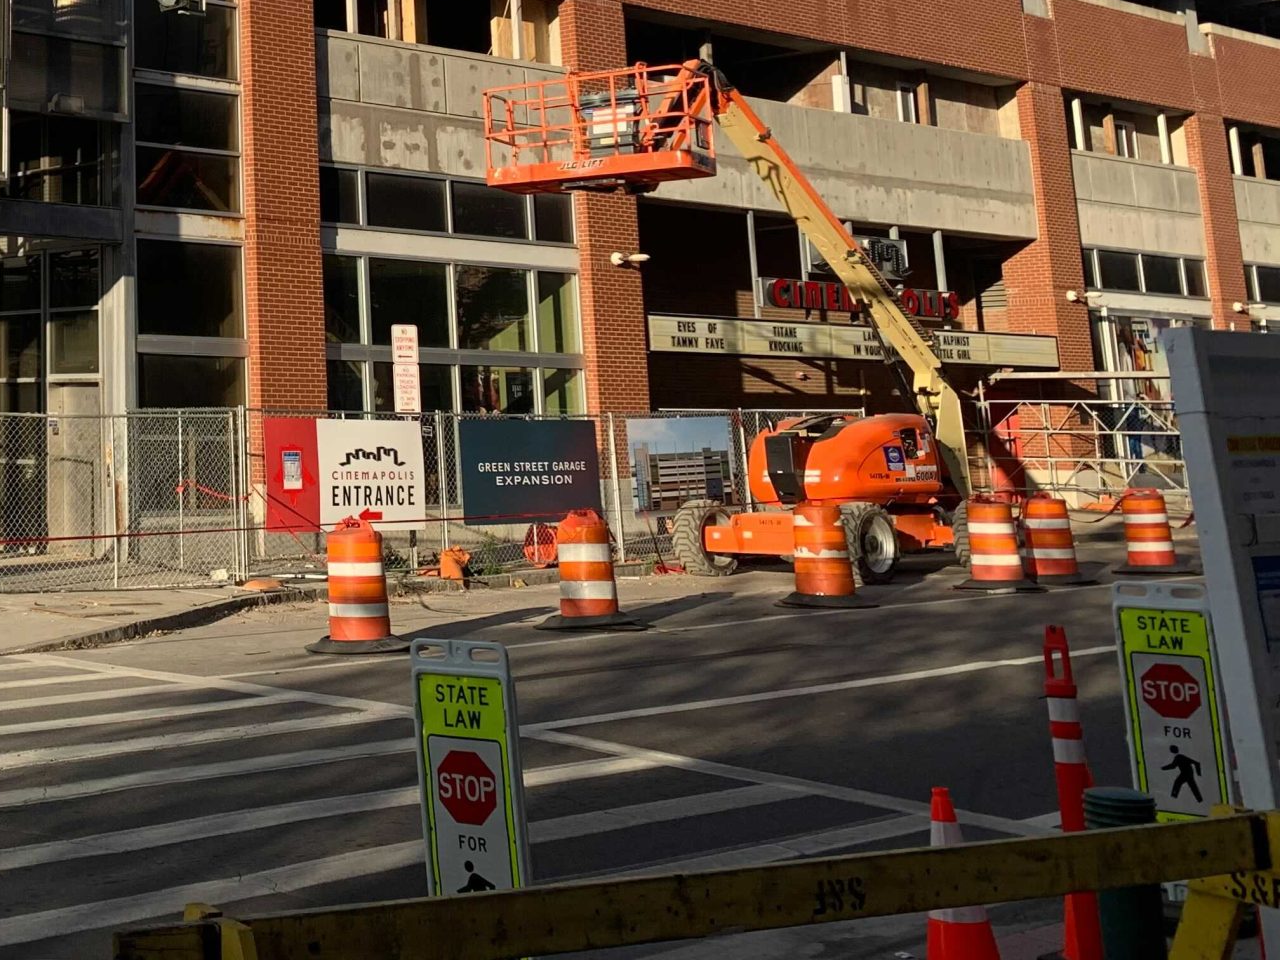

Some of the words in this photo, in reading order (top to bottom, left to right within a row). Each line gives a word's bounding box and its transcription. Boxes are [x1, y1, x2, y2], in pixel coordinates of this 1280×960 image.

[581, 159, 604, 168] LIFT
[677, 321, 696, 333] EYES
[707, 323, 718, 334] OF
[772, 326, 797, 338] TITANE
[671, 336, 699, 348] TAMMY
[705, 338, 725, 350] FAYE
[768, 341, 803, 352] KNOCKING
[943, 335, 970, 347] ALPINIST
[853, 345, 861, 355] IN
[957, 349, 971, 360] GIRL
[478, 462, 512, 473] GREEN
[514, 461, 549, 473] STREET
[551, 460, 587, 472] GARAGE
[331, 470, 415, 481] CINEMAPOLIS
[495, 474, 573, 486] EXPANSION
[331, 485, 416, 507] ENTRANCE
[1137, 615, 1191, 634] STATE
[1146, 634, 1184, 650] LAW
[435, 684, 489, 707] STATE
[1142, 680, 1199, 702] STOP
[444, 708, 481, 730] LAW
[1164, 725, 1192, 739] FOR
[439, 772, 495, 803] STOP
[458, 834, 488, 853] FOR
